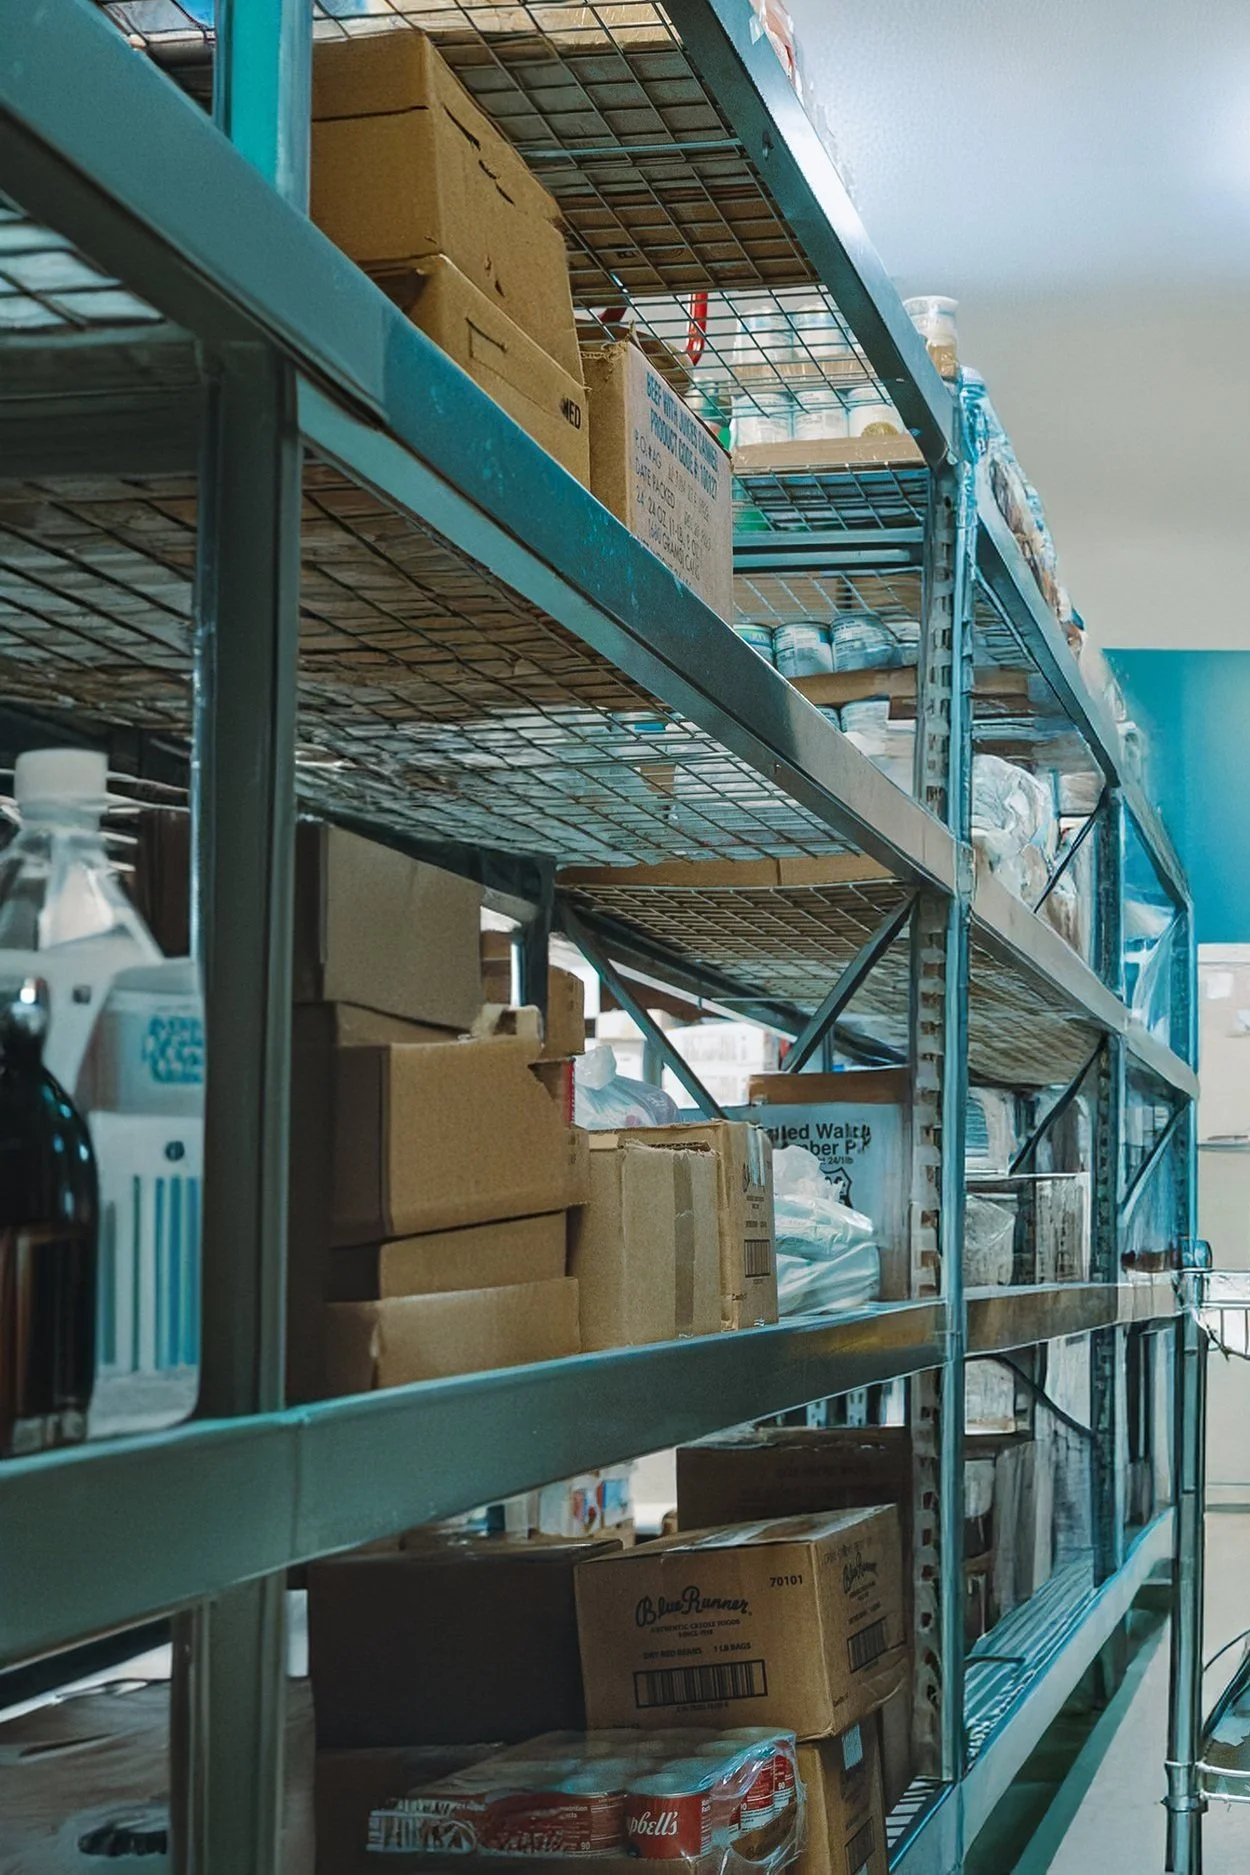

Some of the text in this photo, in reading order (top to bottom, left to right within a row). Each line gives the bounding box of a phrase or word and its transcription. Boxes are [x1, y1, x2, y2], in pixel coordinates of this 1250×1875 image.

[635, 457, 652, 487] DATE
[769, 1574, 803, 1587] 70101
[635, 1585, 750, 1627] Blue Runner
[628, 1811, 678, 1836] pbell's
